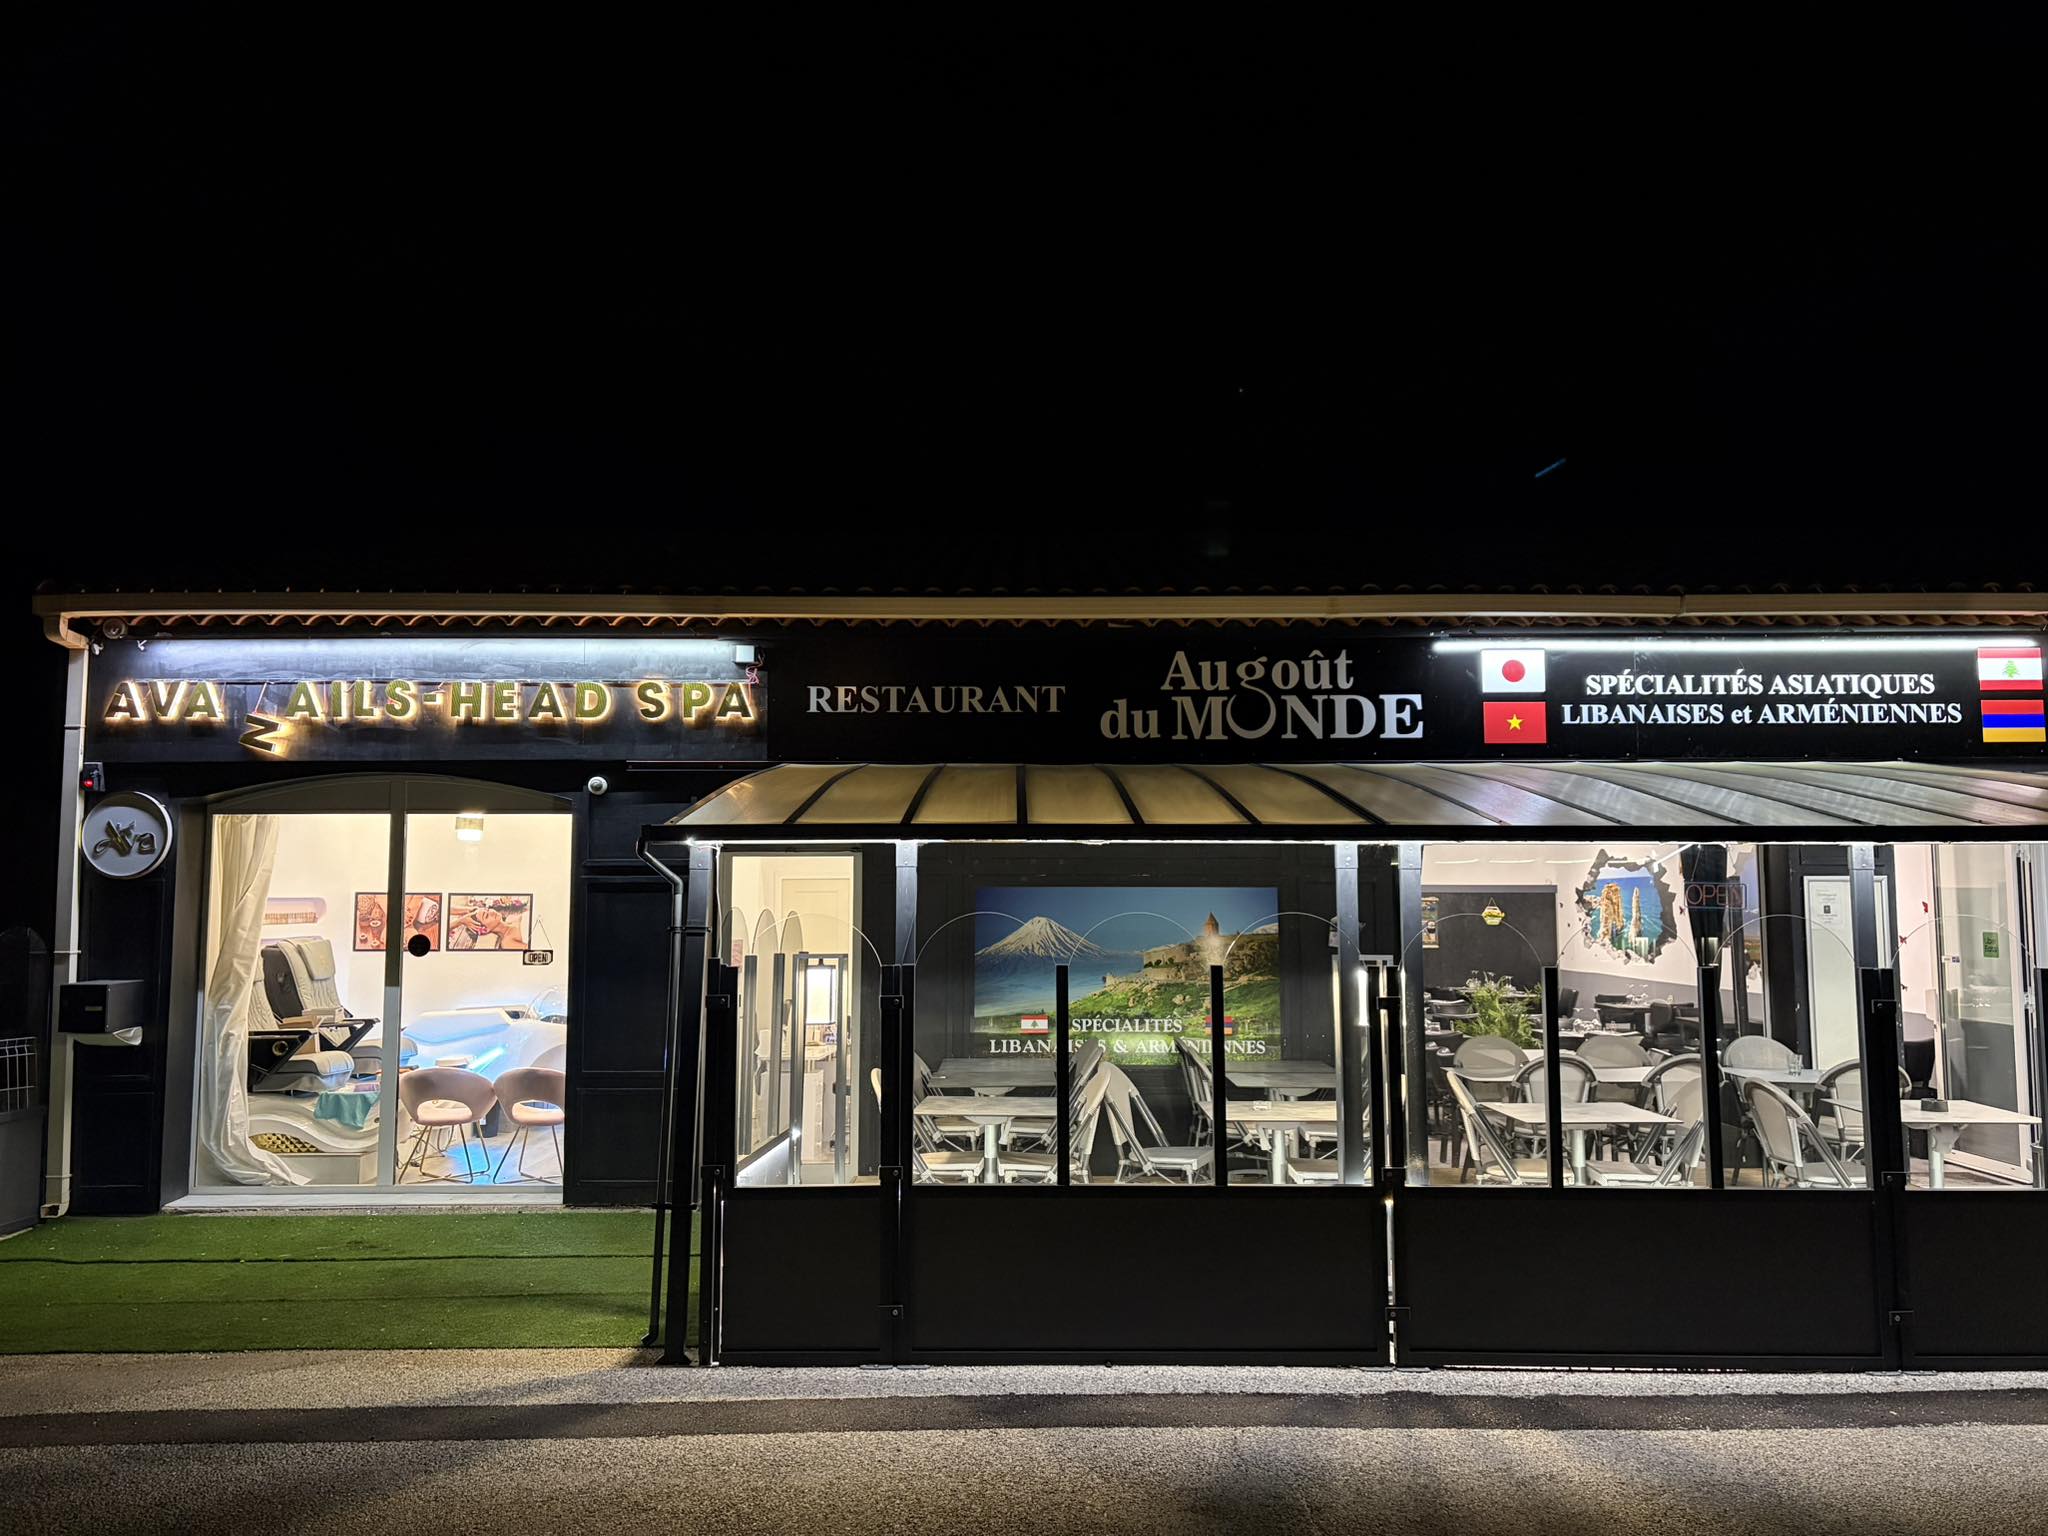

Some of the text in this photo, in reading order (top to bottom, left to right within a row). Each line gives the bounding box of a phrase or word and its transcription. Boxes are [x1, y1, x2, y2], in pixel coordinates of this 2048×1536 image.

[1160, 649, 1354, 691] Au goût
[1585, 669, 1936, 699] SPÉCIALITÉS ASIATIQUES
[104, 680, 225, 720] AVA
[637, 679, 756, 720] SPA
[806, 685, 1066, 714] RESTAURANT
[1561, 698, 1963, 725] LIBANAISES et ARMÉNIENNES
[1100, 694, 1424, 740] du MONDE
[1685, 884, 1744, 906] OPEN
[528, 952, 549, 963] OPEN
[1071, 1015, 1183, 1033] SPÉCIALITÉS
[989, 1036, 1267, 1055] LIBANISS & ARMNINNES
